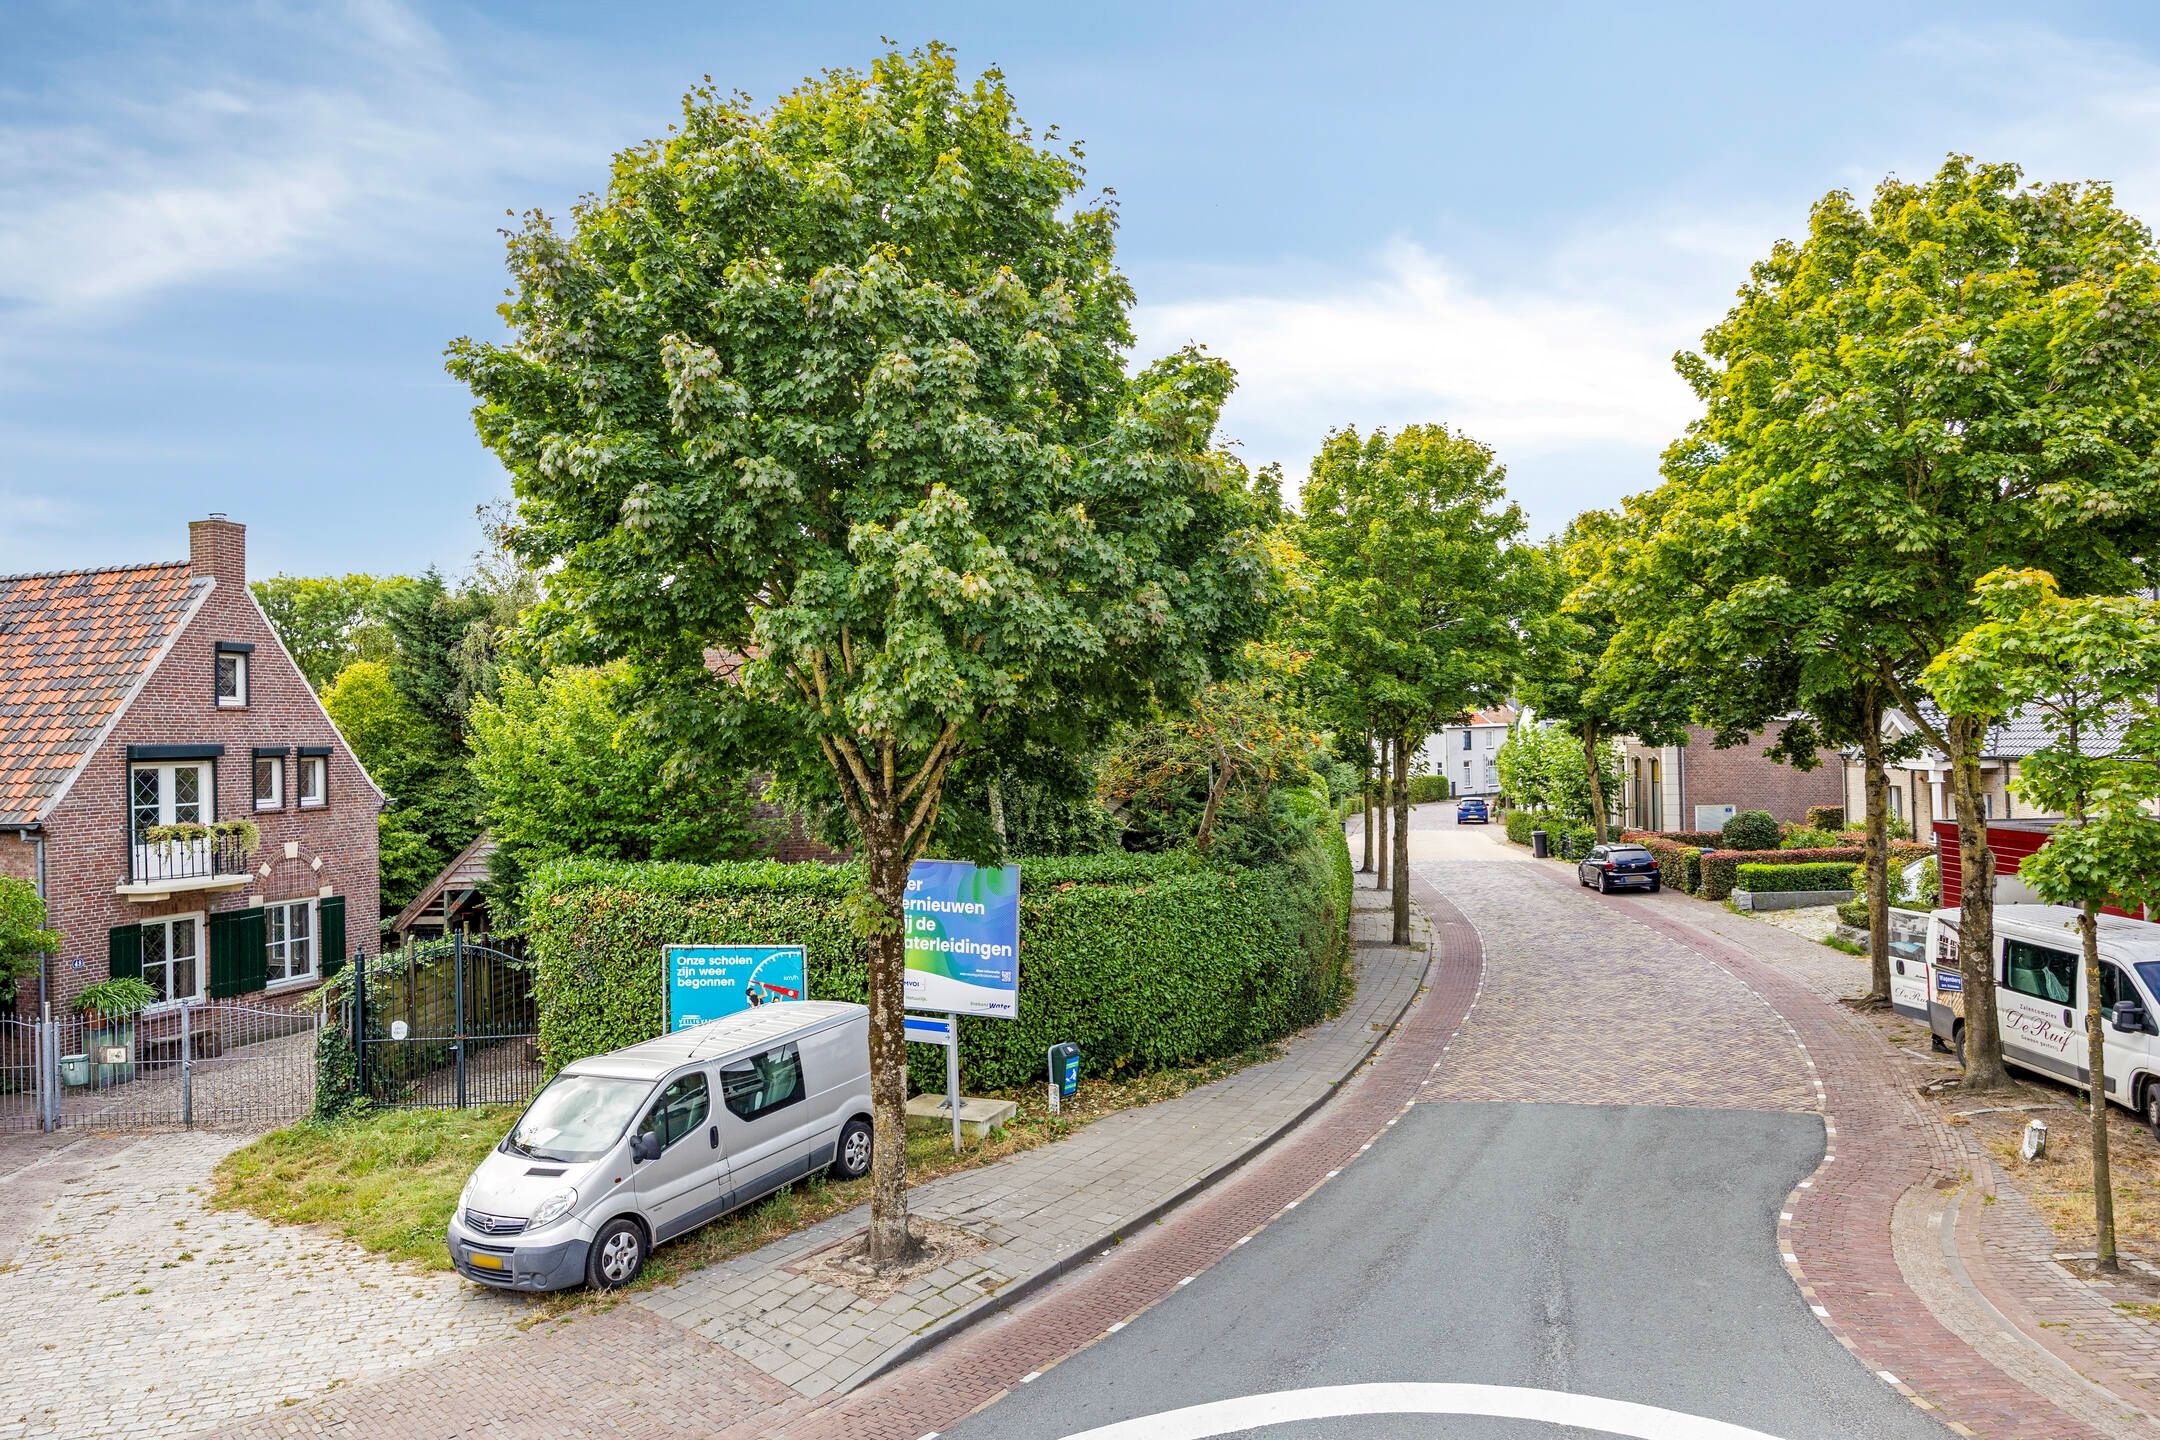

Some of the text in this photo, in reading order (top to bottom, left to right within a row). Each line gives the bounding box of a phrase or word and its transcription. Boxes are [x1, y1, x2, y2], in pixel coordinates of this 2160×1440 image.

[906, 880, 923, 891] er
[903, 896, 985, 915] ernieuwen
[904, 915, 936, 934] ij de
[904, 937, 1012, 960] aterleidingen
[676, 955, 753, 966] Onze scholen
[676, 966, 727, 979] zijn weer
[677, 977, 736, 990] begonnen
[989, 1002, 1012, 1010] Water
[2006, 1008, 2029, 1033] De
